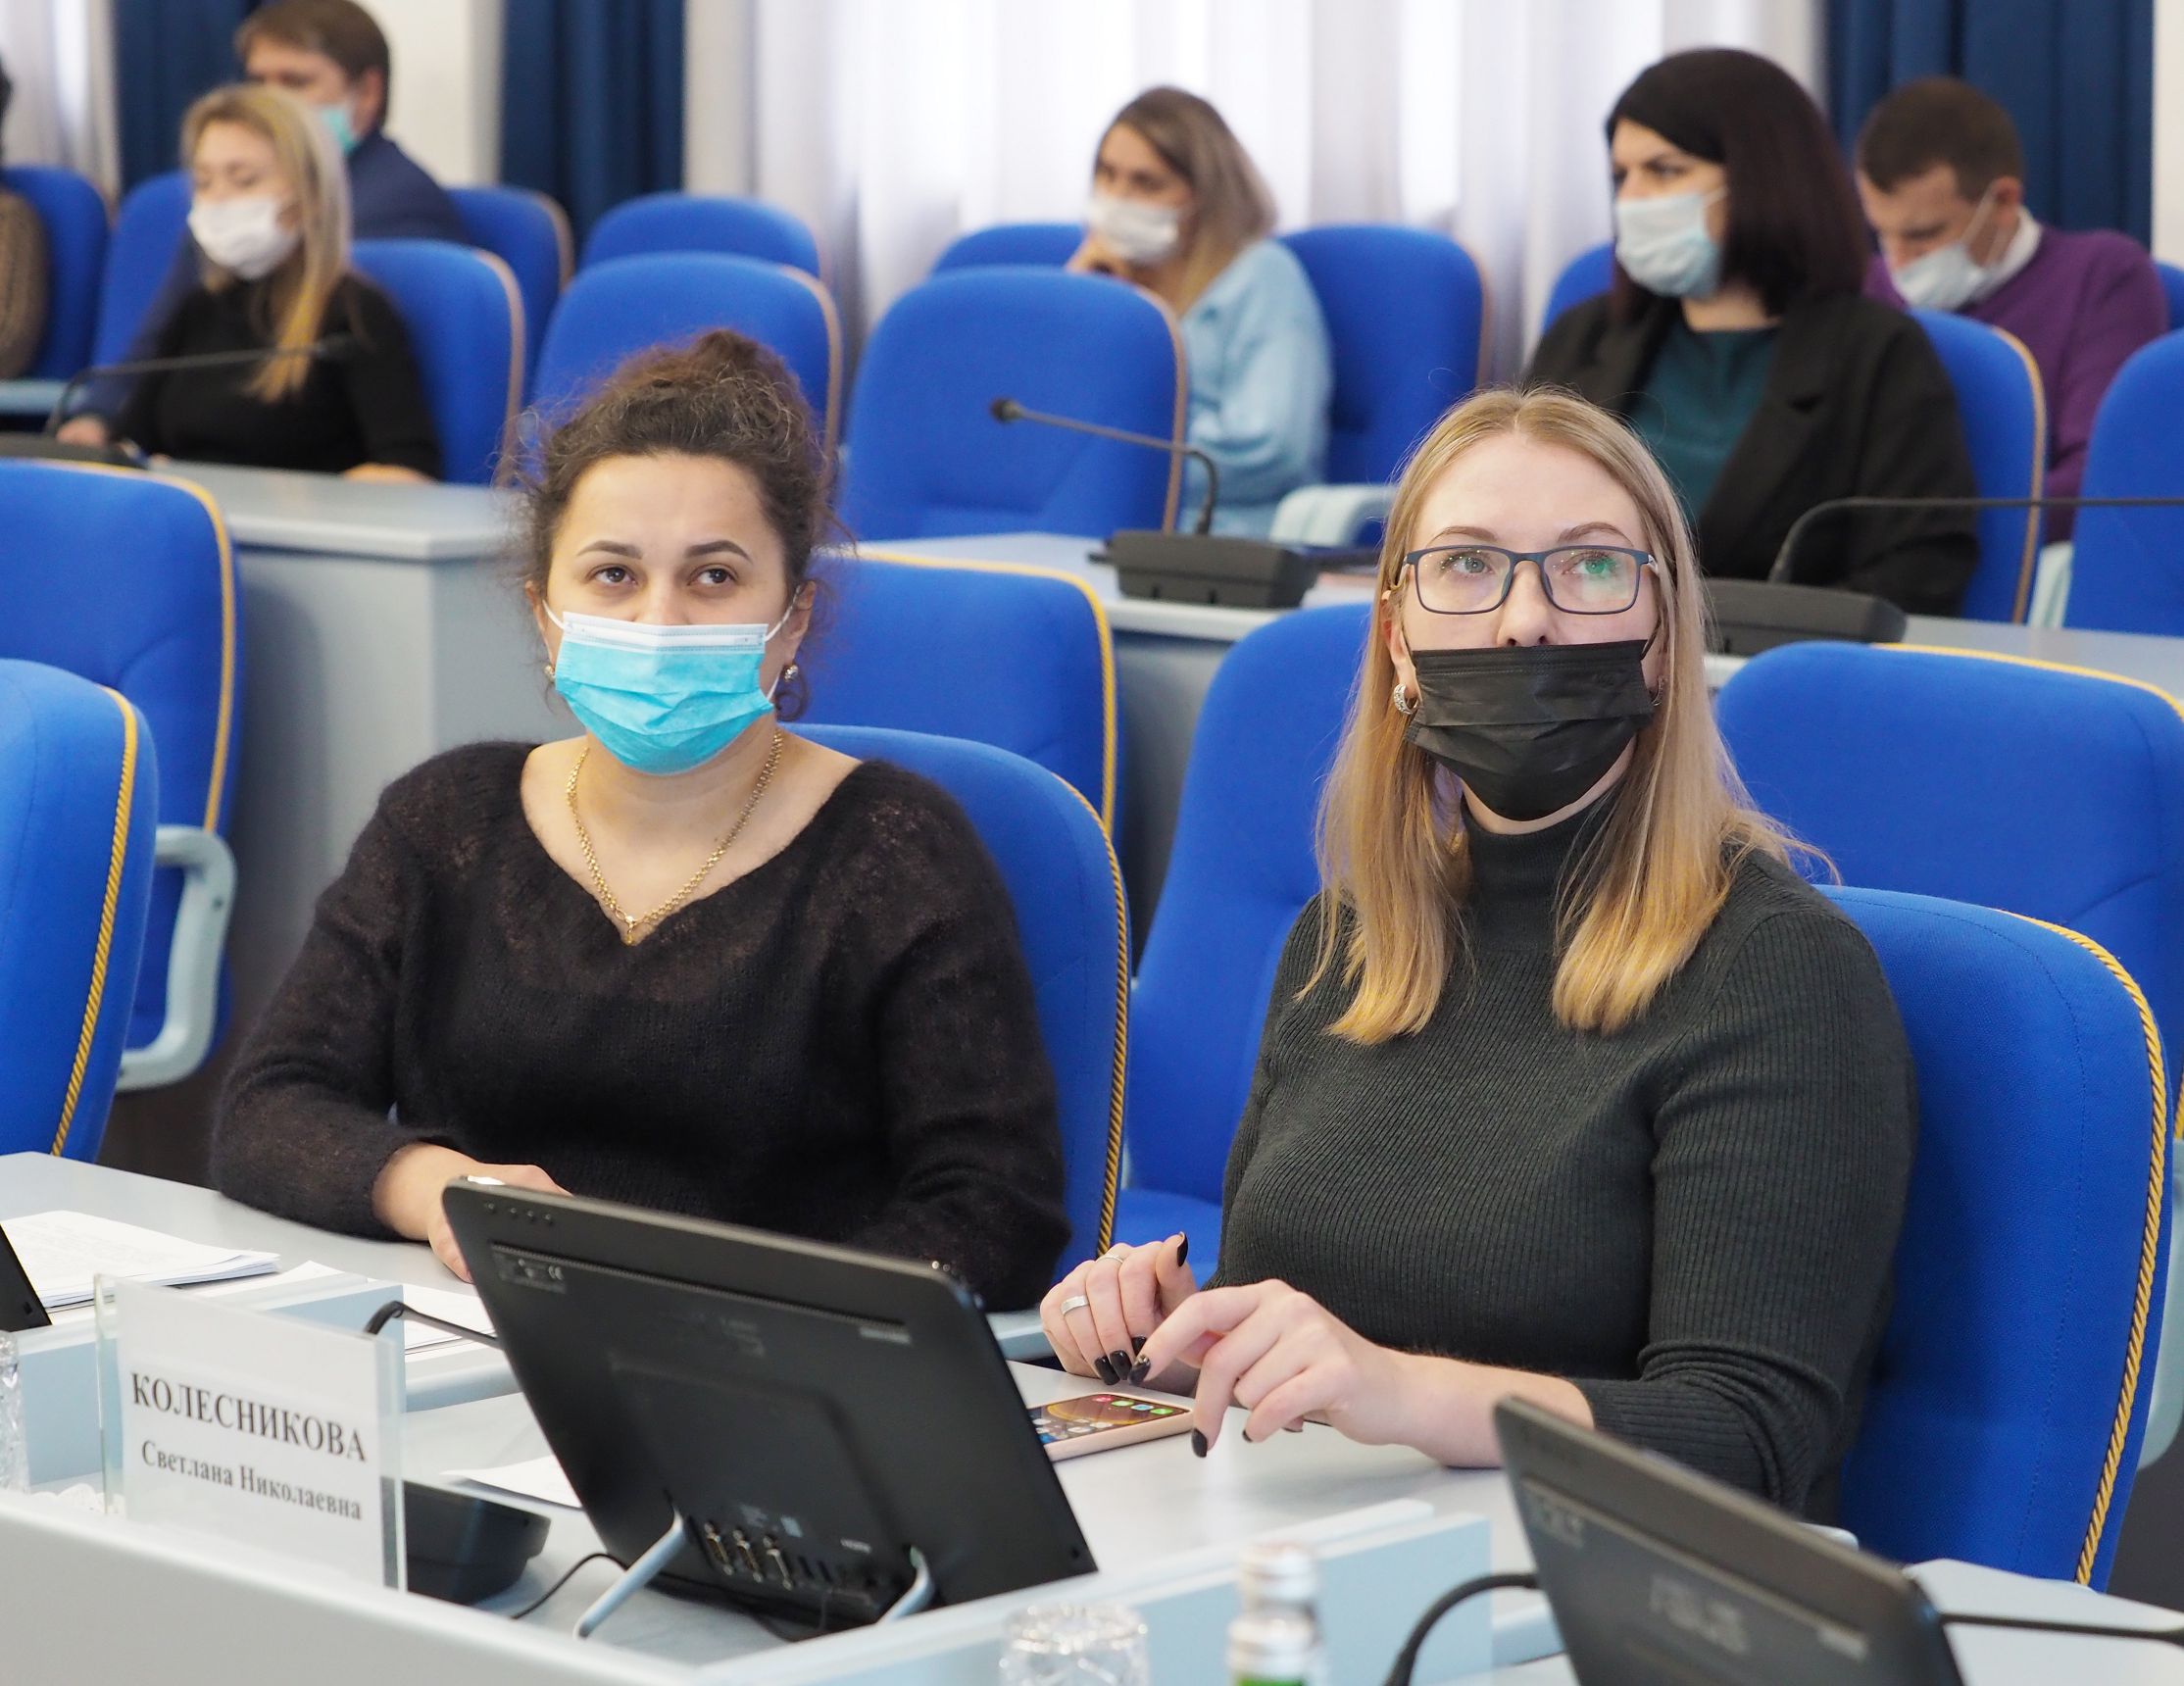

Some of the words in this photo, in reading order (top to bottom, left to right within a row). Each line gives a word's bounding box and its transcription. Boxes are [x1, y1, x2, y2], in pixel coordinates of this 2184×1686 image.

[130, 1372, 367, 1462] КОЛЕСНИКОВА
[141, 1439, 233, 1487] Светлана
[239, 1465, 362, 1518] Николаевна
